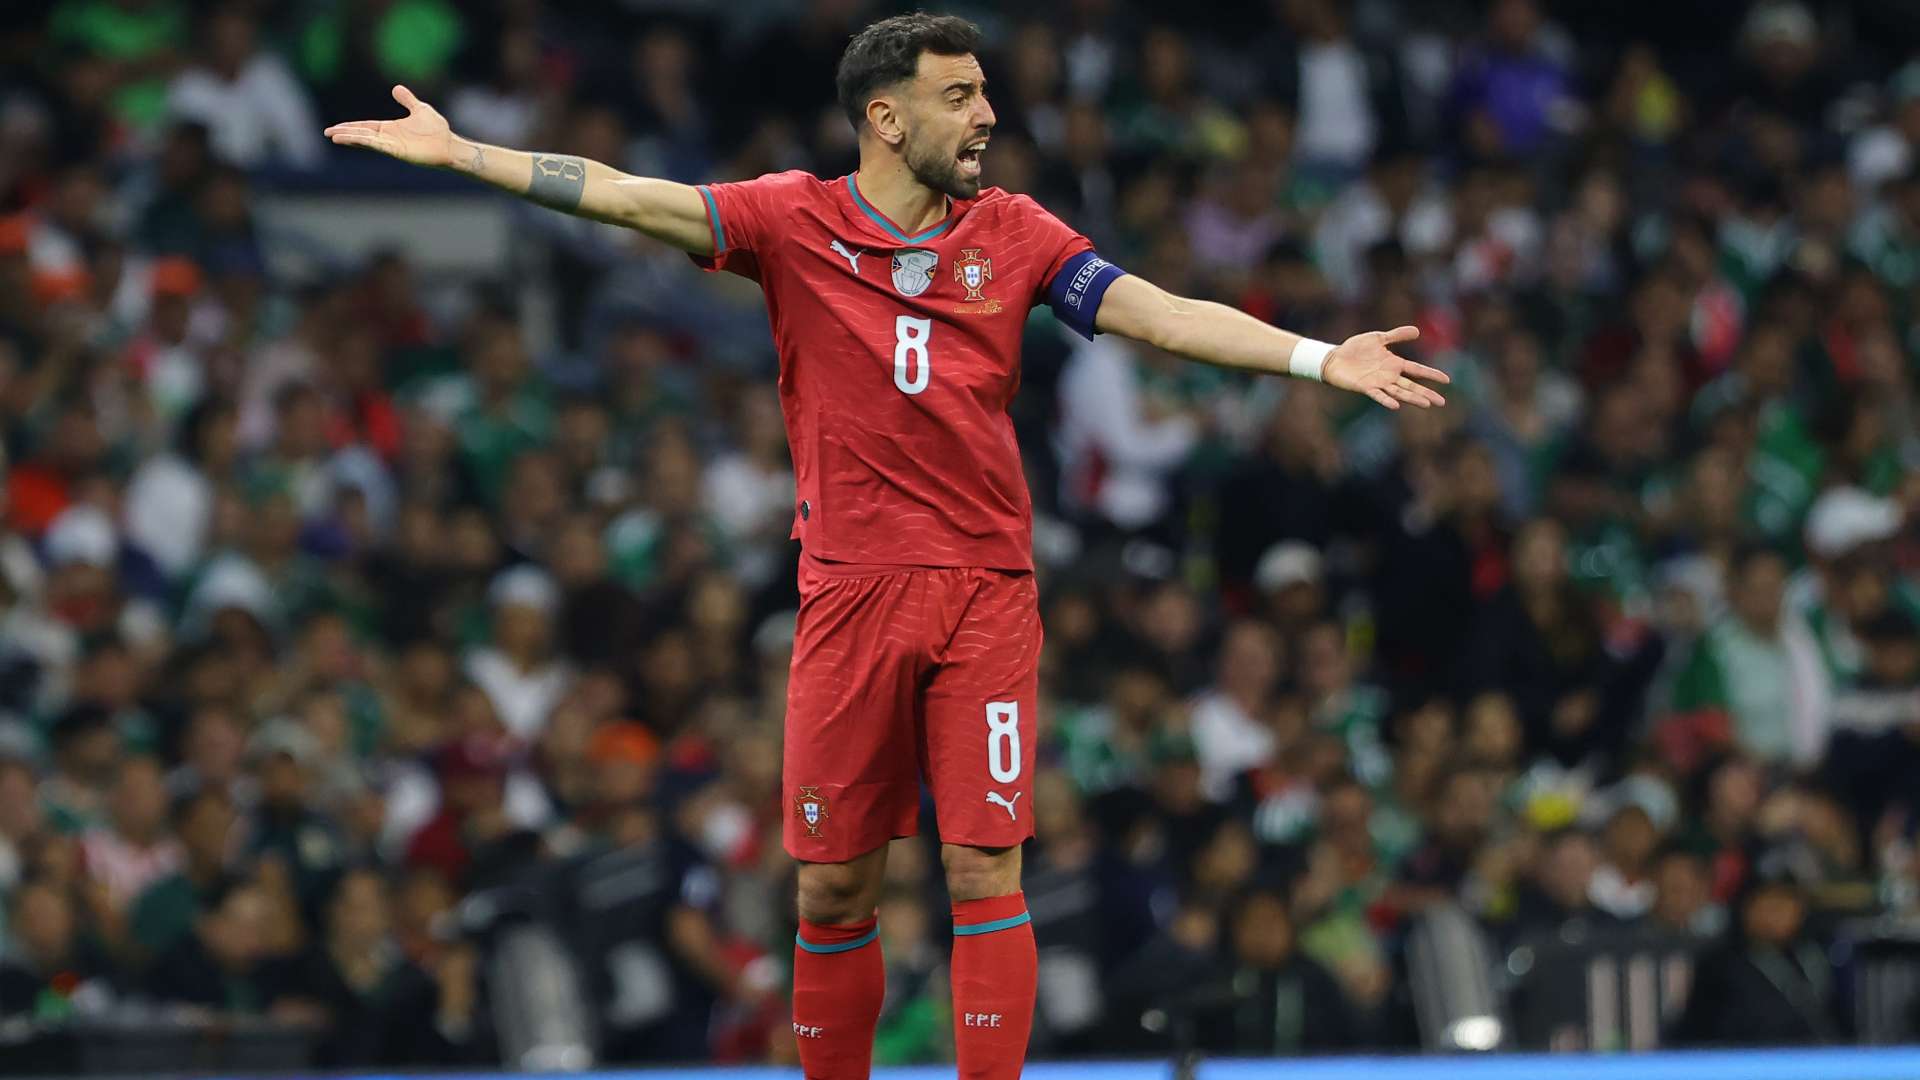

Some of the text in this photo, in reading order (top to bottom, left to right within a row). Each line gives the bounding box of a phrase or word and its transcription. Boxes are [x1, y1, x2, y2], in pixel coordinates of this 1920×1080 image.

[1073, 259, 1109, 292] RESPE
[894, 316, 931, 394] 8
[986, 700, 1020, 783] 8
